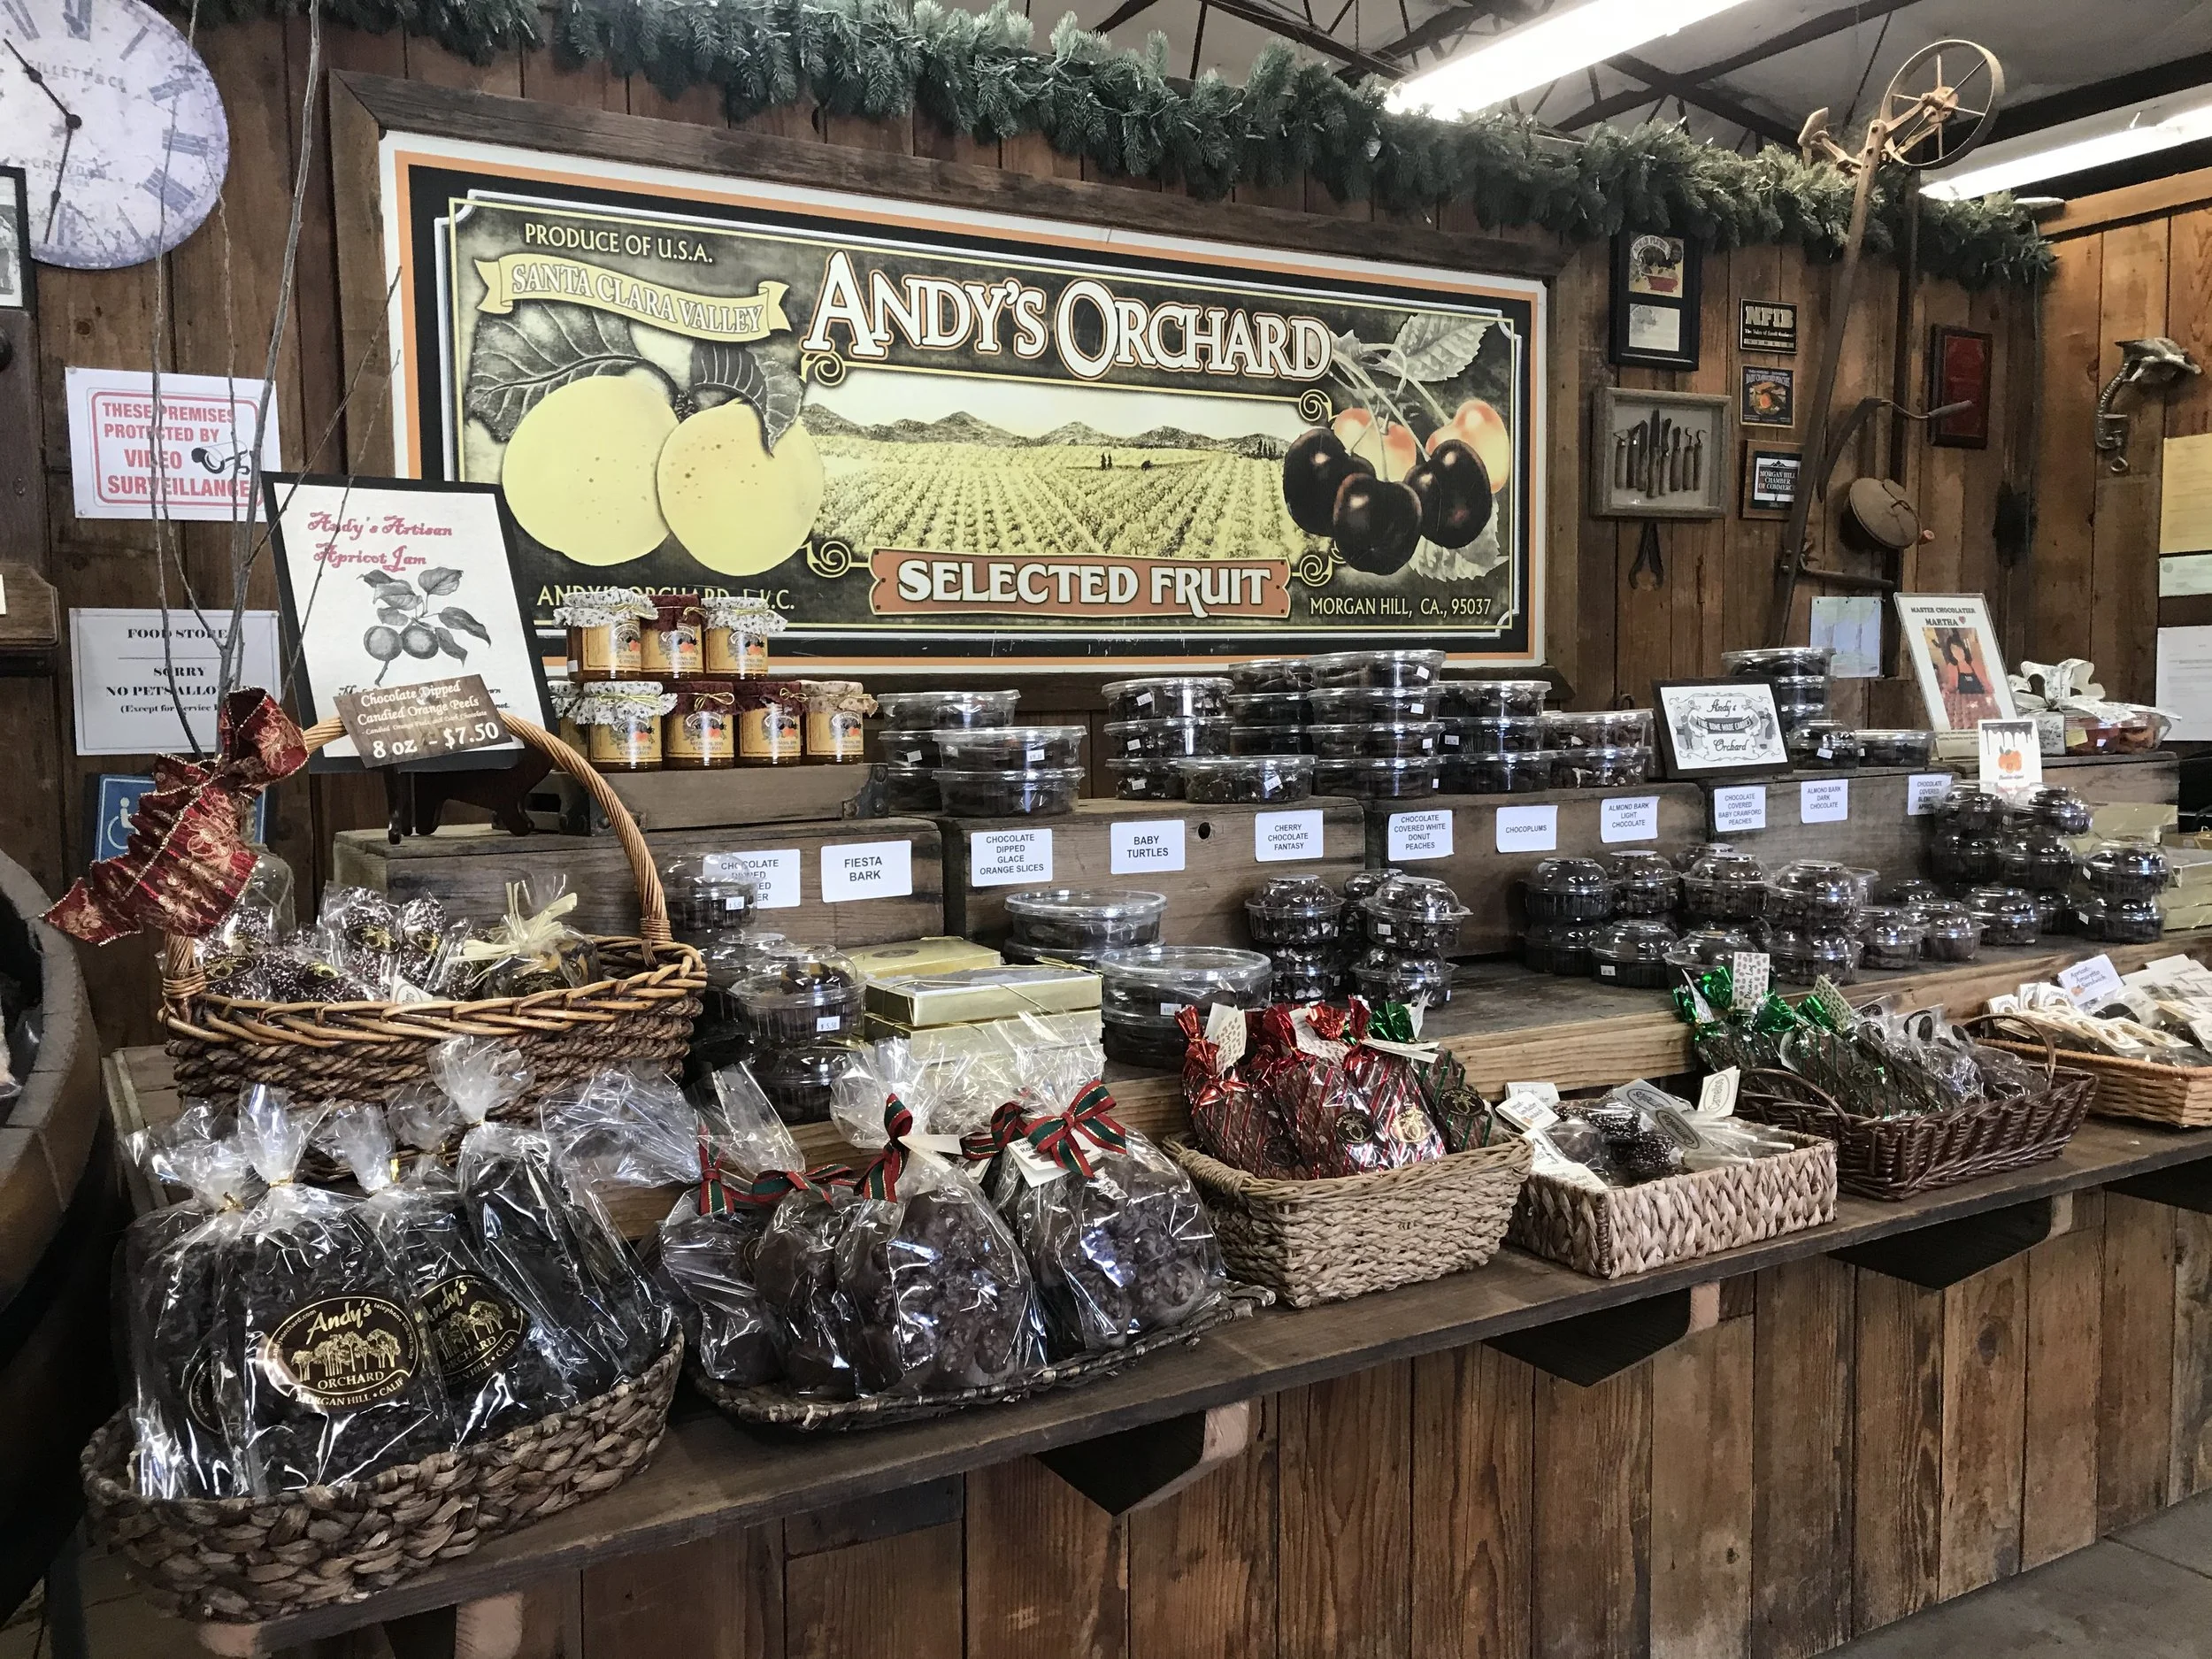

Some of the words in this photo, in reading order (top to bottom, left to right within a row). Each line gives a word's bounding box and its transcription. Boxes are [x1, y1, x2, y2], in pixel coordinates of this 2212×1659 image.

[526, 223, 620, 253] PRODUCE
[625, 234, 651, 256] OF
[657, 237, 713, 264] U.S.A.
[511, 263, 593, 298] SANTA
[595, 273, 679, 324] CLARA
[681, 301, 764, 334] VALLEY
[801, 250, 1048, 360] ANDY'S
[1056, 278, 1333, 381] ORCHARD
[1745, 305, 1794, 328] NFIB
[103, 403, 152, 419] THESE
[200, 427, 219, 442] BY
[308, 511, 378, 541] Andy's
[382, 516, 453, 537] Artisan
[313, 542, 388, 569] Apricot
[382, 545, 427, 572] Jam
[897, 558, 1139, 606] SELECTED
[1151, 565, 1272, 619] FRUIT
[1310, 596, 1377, 617] MORGAN
[1379, 597, 1413, 618] HILL,
[1420, 598, 1448, 618] CA.,
[1451, 598, 1492, 616] 95037
[1925, 618, 1959, 626] MARTHA
[127, 628, 173, 639] FOOD
[106, 686, 128, 697] NO
[133, 686, 172, 697] PETS
[176, 685, 219, 696] ALLO
[361, 687, 418, 708] Chocolate
[417, 680, 462, 706] Dipped
[176, 704, 212, 713] ervice
[357, 707, 406, 726] Candied
[407, 702, 449, 718] Orange
[449, 695, 480, 710] Peels
[373, 741, 387, 759] 8
[392, 739, 418, 755] oz
[443, 721, 499, 749] $7.50
[1633, 802, 1650, 810] BARK
[1809, 801, 1839, 810] CHOCOLATE
[1401, 814, 1440, 823] CHOCOLATE
[1620, 811, 1638, 820] LIGHT
[1733, 809, 1763, 818] CRAWFORD
[1274, 823, 1302, 833] CHERRY
[1394, 824, 1425, 833] COVERED
[1611, 818, 1646, 828] CHOCOLATE
[1505, 825, 1548, 834] CHOCOPLUMS
[986, 833, 1035, 843] CHOCOLATE
[1133, 835, 1160, 846] BABY
[1267, 833, 1309, 841] CHOCOLATE
[995, 844, 1025, 854] DIPPED
[1274, 842, 1305, 851] FANTASY
[1405, 841, 1435, 850] PEACHES
[1126, 847, 1169, 859] TURTLES
[721, 859, 780, 870] CHOCOLATE
[844, 856, 883, 869] FIESTA
[997, 855, 1025, 864] GLACE
[979, 865, 1015, 875] ORANGE
[1016, 864, 1044, 873] SLICES
[849, 870, 881, 881] BARK
[429, 1279, 468, 1322] ndy's
[306, 1299, 373, 1345] Andy's
[373, 1302, 403, 1323] telephone
[442, 1336, 497, 1373] ORCHARD
[470, 1359, 491, 1377] HILL
[495, 1337, 517, 1357] CALIF
[317, 1371, 385, 1390] ORCHARD
[296, 1393, 345, 1406] MORGAN
[347, 1394, 372, 1406] HILL
[379, 1377, 404, 1397] CALIF
